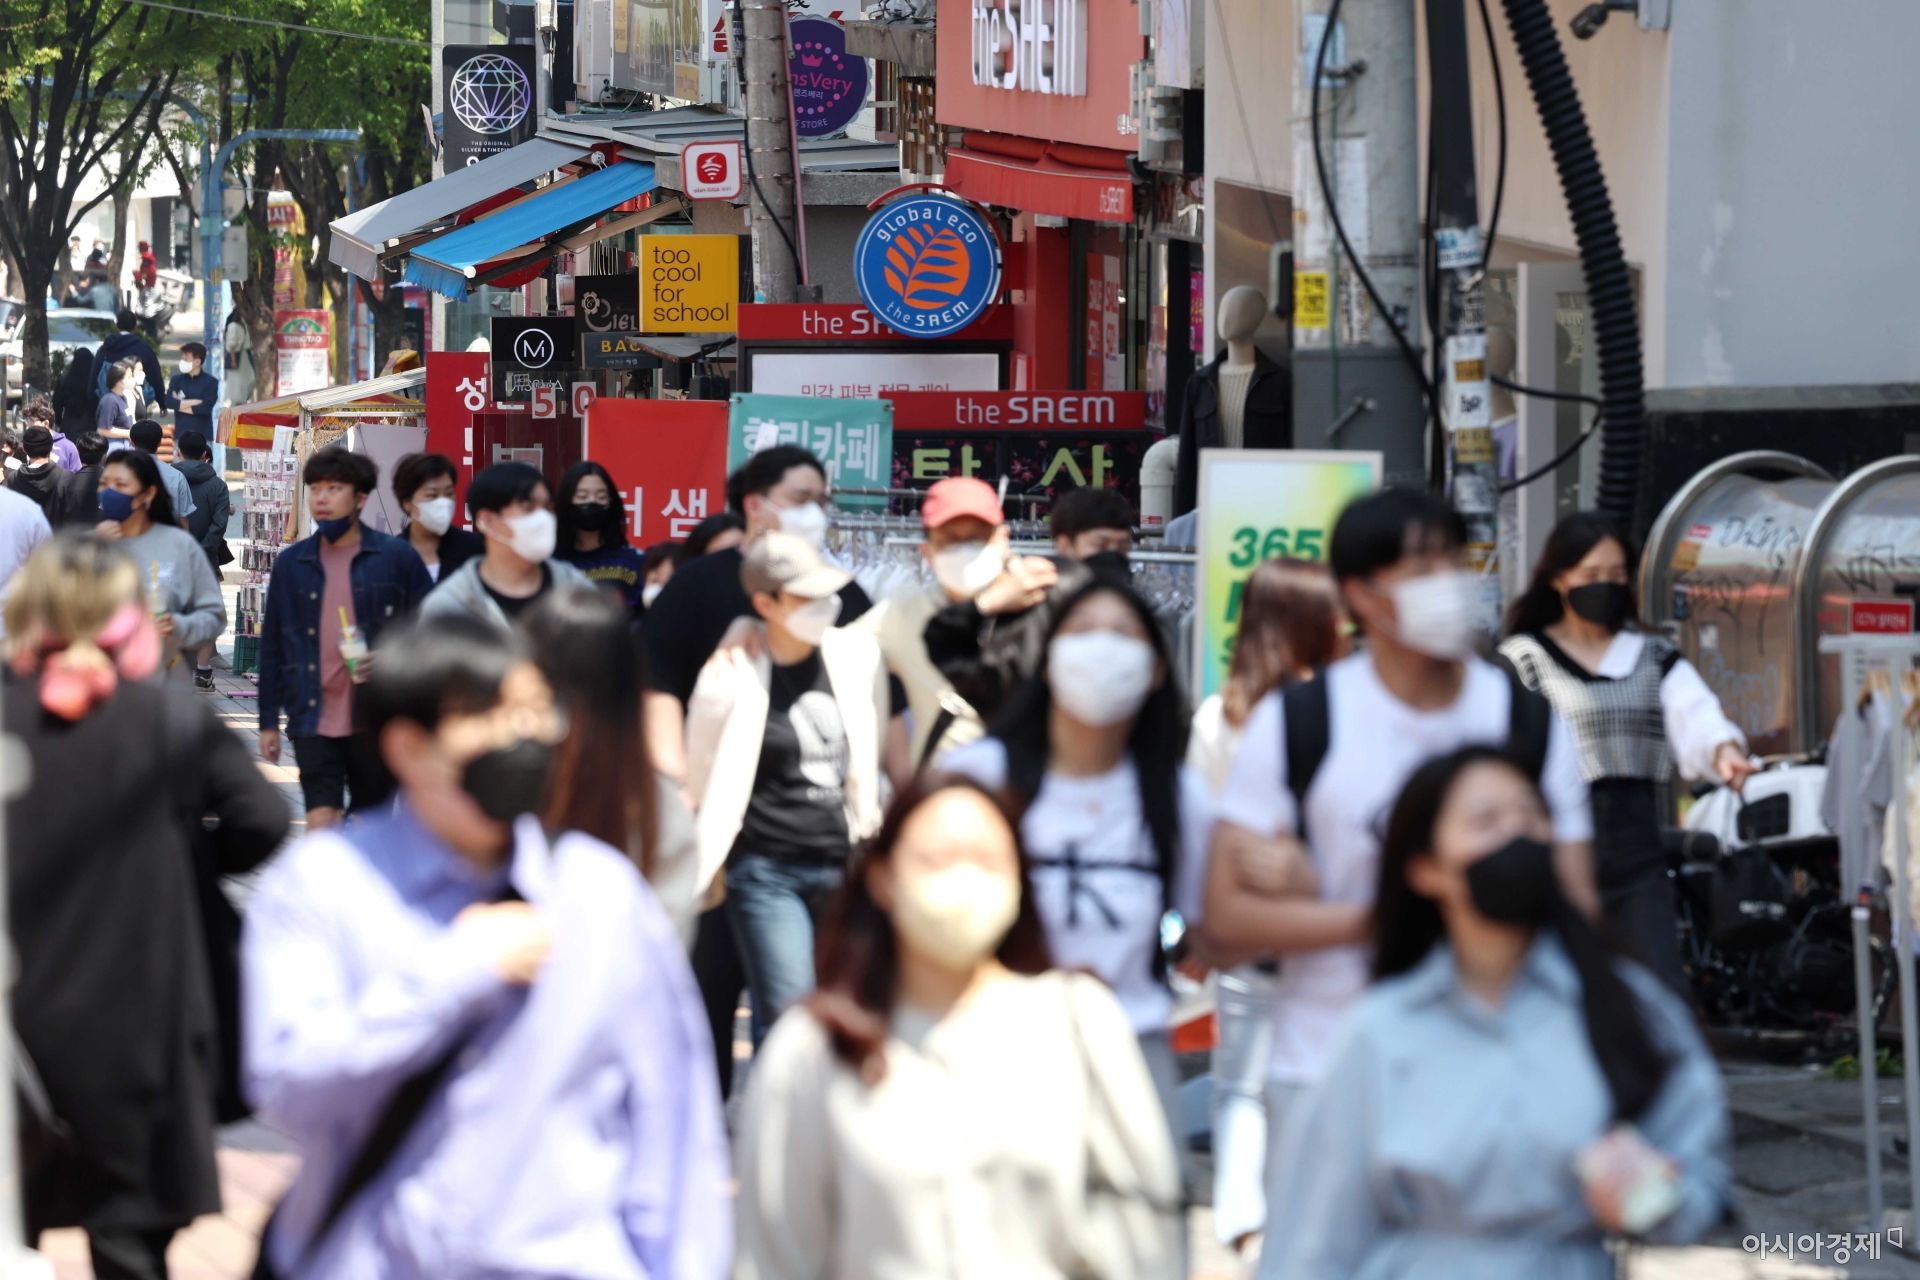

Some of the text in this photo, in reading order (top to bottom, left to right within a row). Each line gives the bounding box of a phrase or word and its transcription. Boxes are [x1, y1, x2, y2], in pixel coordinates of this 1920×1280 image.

[792, 72, 853, 97] nsVery
[800, 118, 829, 129] STORE
[876, 206, 977, 243] global eco
[653, 246, 690, 264] too
[653, 262, 701, 281] cool
[653, 283, 684, 302] for
[653, 302, 729, 321] school
[802, 309, 843, 335] the
[886, 301, 970, 327] the SAEM
[955, 397, 1115, 424] the SAEM
[1229, 526, 1323, 567] 365
